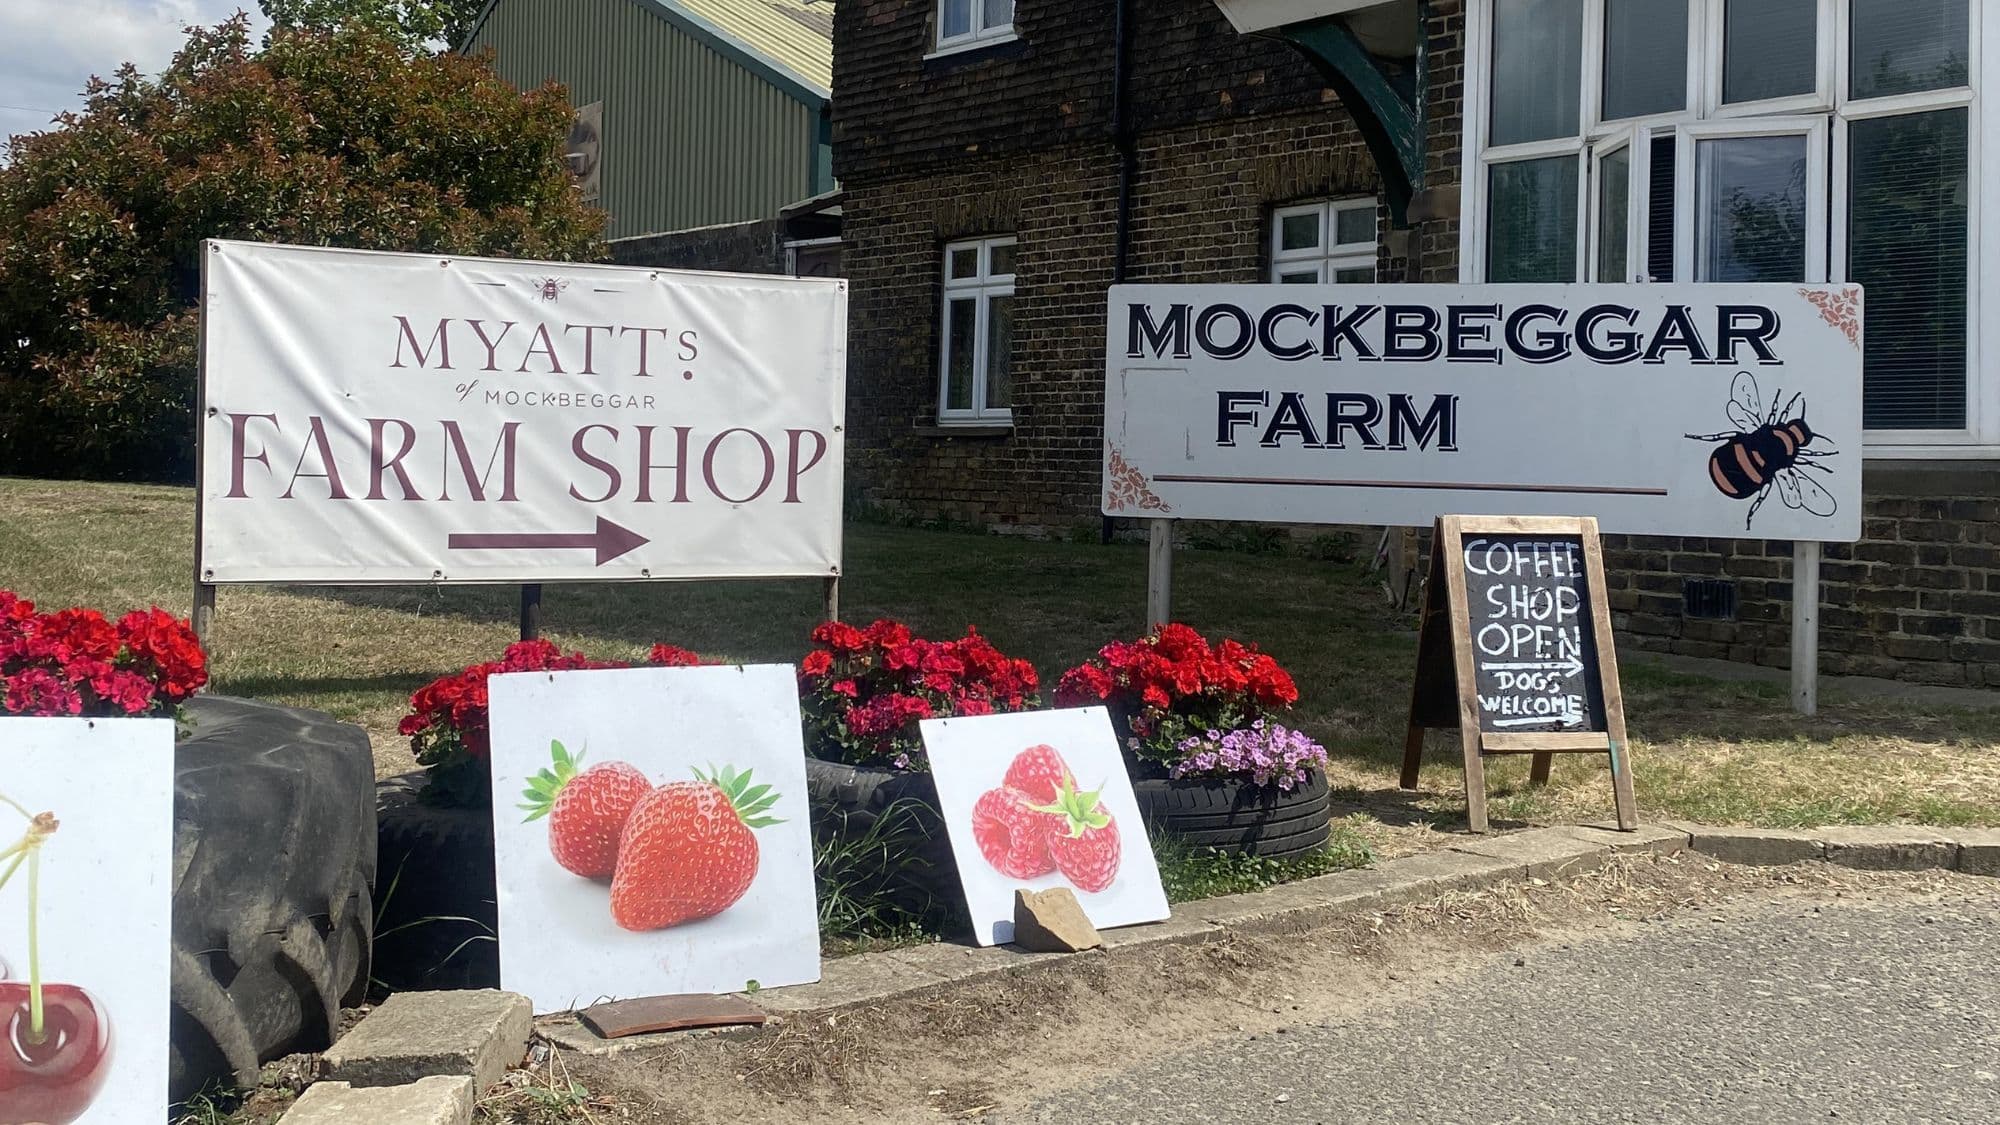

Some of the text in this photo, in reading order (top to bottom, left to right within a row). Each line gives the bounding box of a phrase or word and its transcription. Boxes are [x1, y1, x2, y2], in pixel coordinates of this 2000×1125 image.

[1126, 303, 1784, 366] MOCKBEGGAR
[455, 379, 656, 410] of MOCKBEGGAR
[1215, 389, 1460, 453] FARM
[222, 413, 827, 504] FARM SHOP
[1464, 539, 1582, 577] COFFEE
[1486, 584, 1580, 623] SHOP
[1477, 622, 1581, 659] OPEN
[1493, 671, 1561, 693] DOGS
[1477, 694, 1583, 715] WELCOME
